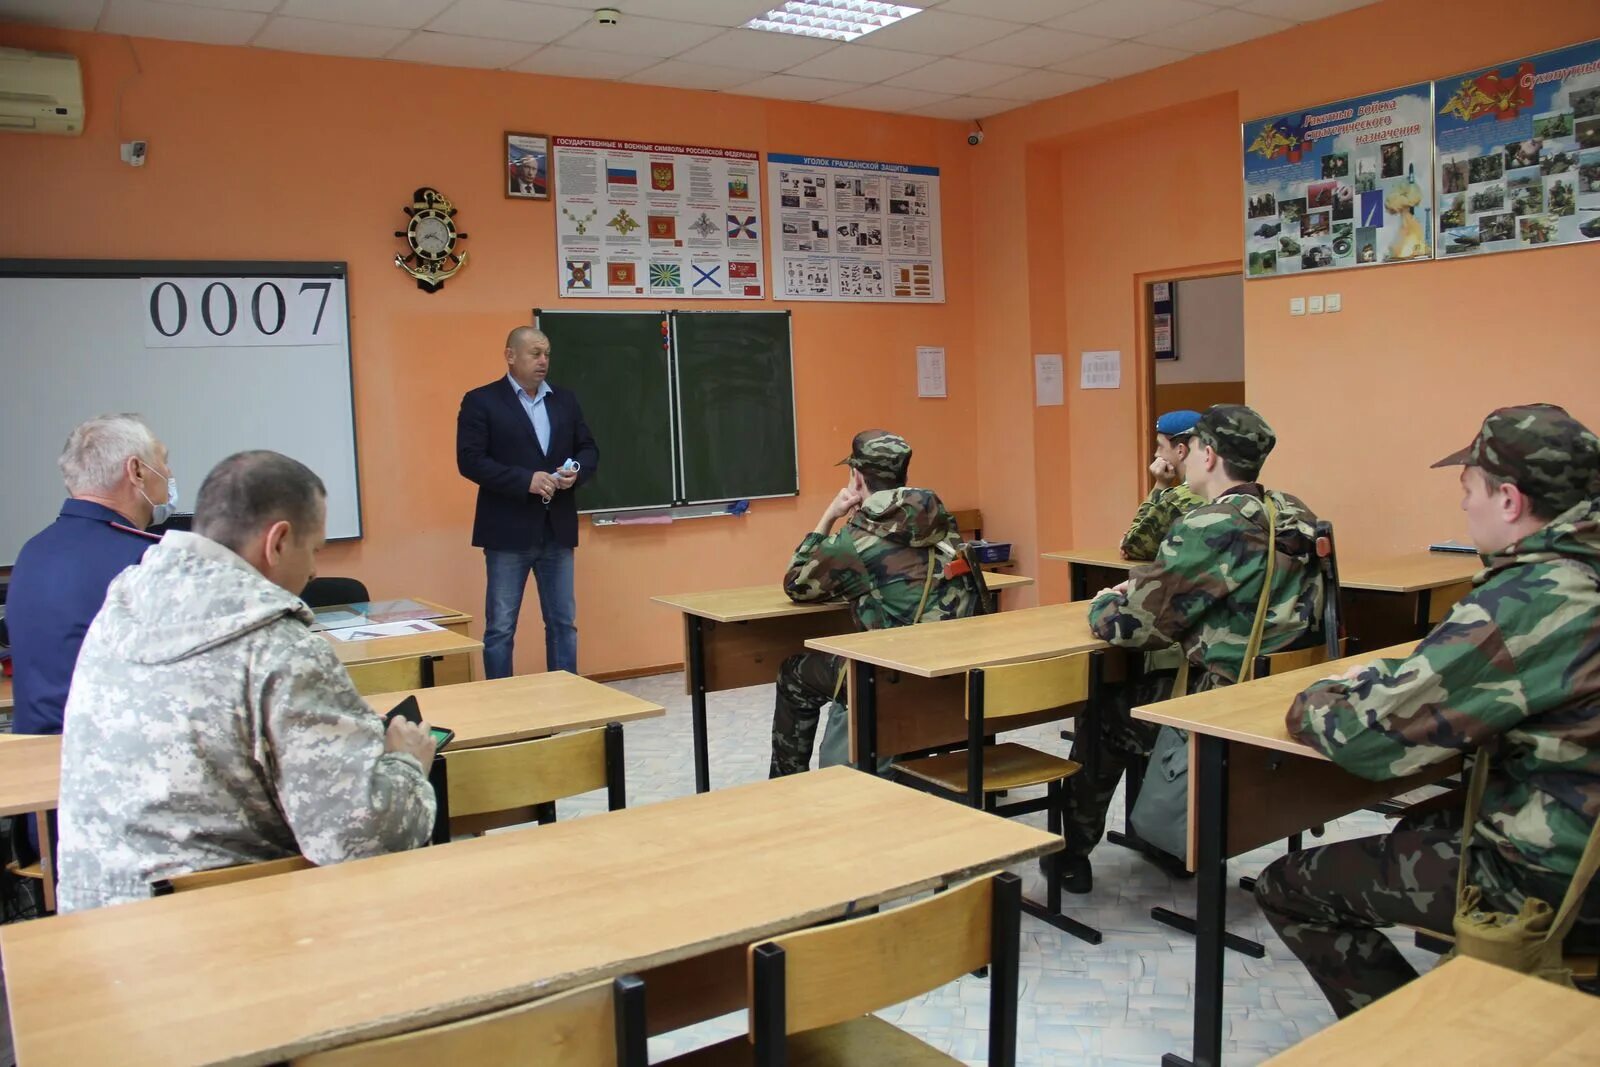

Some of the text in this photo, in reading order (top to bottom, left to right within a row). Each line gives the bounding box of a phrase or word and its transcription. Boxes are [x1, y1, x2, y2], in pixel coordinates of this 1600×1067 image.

[1304, 99, 1397, 127] Ракетные войска
[1303, 115, 1393, 142] стратегического
[1355, 123, 1421, 145] назначения
[556, 138, 617, 148] ГОСУДАРСТВЕННЫЕ
[624, 143, 653, 151] ВОЕННЫЕ
[654, 145, 685, 153] СИМВОЛЫ
[686, 147, 723, 156] РОССИЙСКОЙ
[724, 150, 758, 159] ФЕДЕРАЦИИ
[803, 157, 909, 172] УГОЛОК ГРАЖДАНСКОЙ ЗАЩИТЫ
[150, 281, 332, 336] 0007
